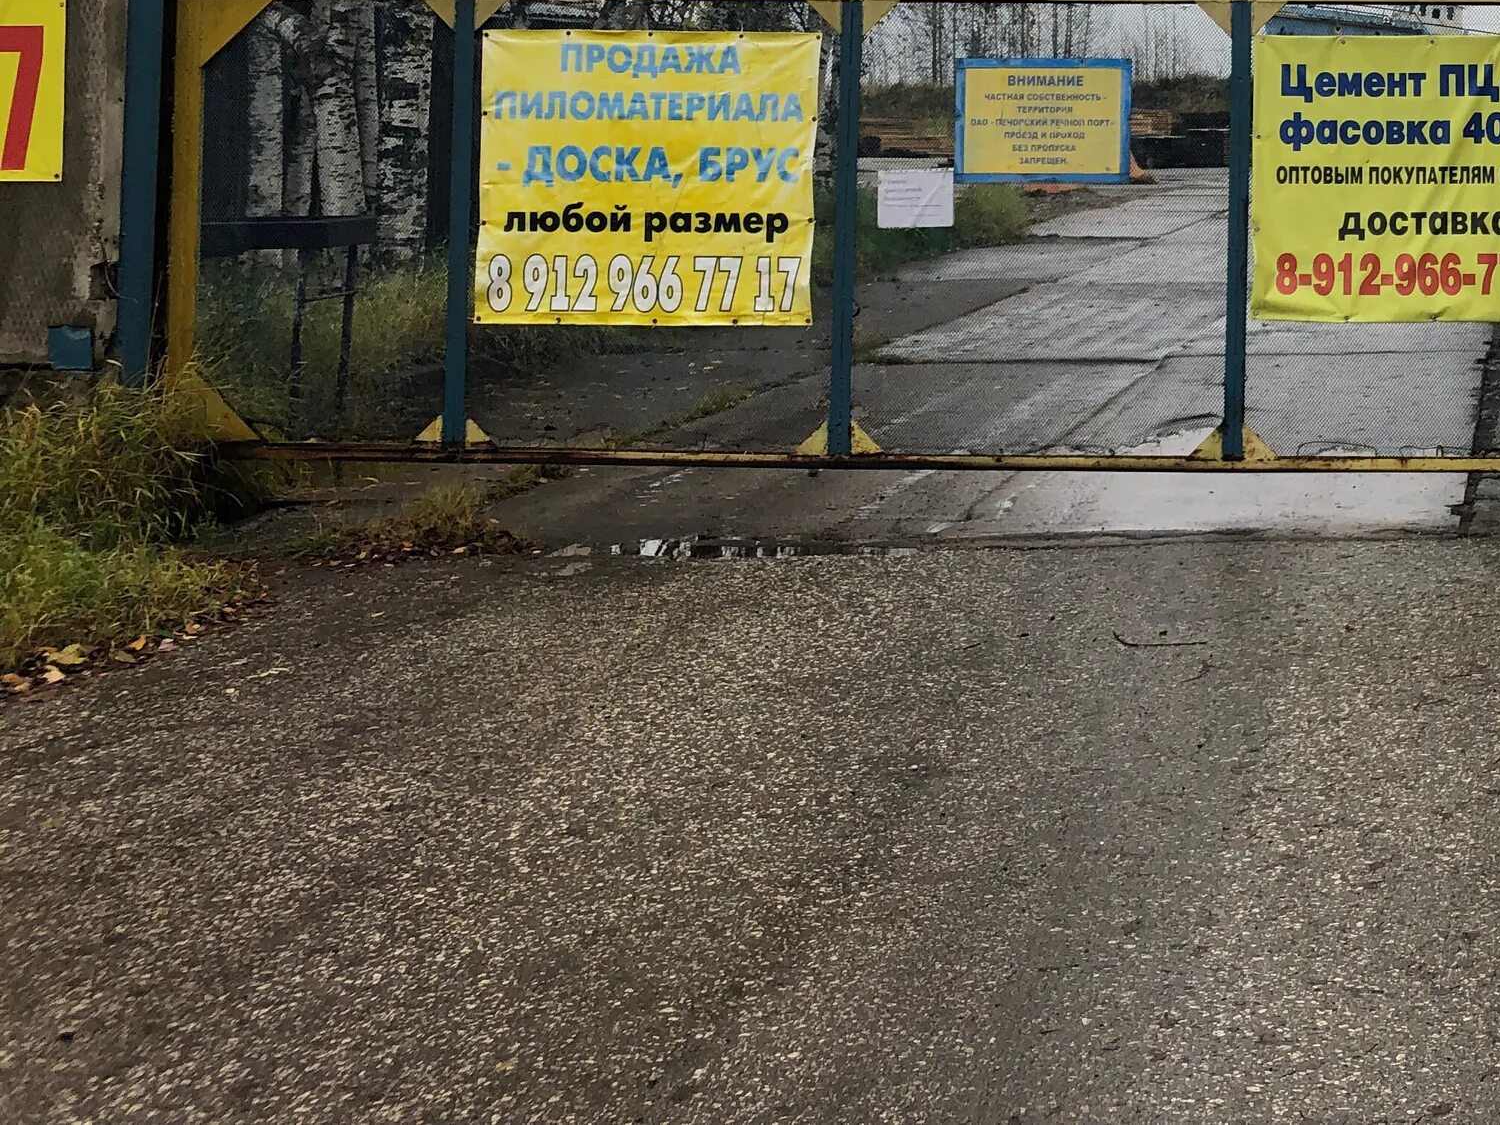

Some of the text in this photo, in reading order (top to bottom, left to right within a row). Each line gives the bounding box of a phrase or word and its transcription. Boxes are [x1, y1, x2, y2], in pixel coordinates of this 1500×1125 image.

[560, 43, 742, 78] ПРОДАЖА
[1007, 75, 1084, 87] ВНИМАНИЕ
[1280, 63, 1427, 103] Цемент
[494, 91, 804, 122] ПИЛОМАТЕРИАЛА
[985, 93, 1024, 101] ЧАСТНАЯ
[1027, 93, 1101, 101] СОБСТВЕННОСТЬ
[1016, 106, 1073, 114] ТЕРРИТОРИЯ
[1004, 131, 1039, 140] ПРОЕЗД
[1049, 131, 1085, 140] ПРОХОД
[1278, 112, 1451, 152] фасовка
[1011, 144, 1076, 152] БЕЗ ПРОПУСКА
[523, 145, 686, 189] ДОСКА,
[699, 146, 800, 183] БРУС
[1276, 165, 1361, 185] ОПТОВЫМ
[1368, 165, 1497, 185] ПОКУПАТЕЛЯМ
[504, 202, 789, 243] любой размер
[487, 253, 802, 313] 8 912 966 77 17
